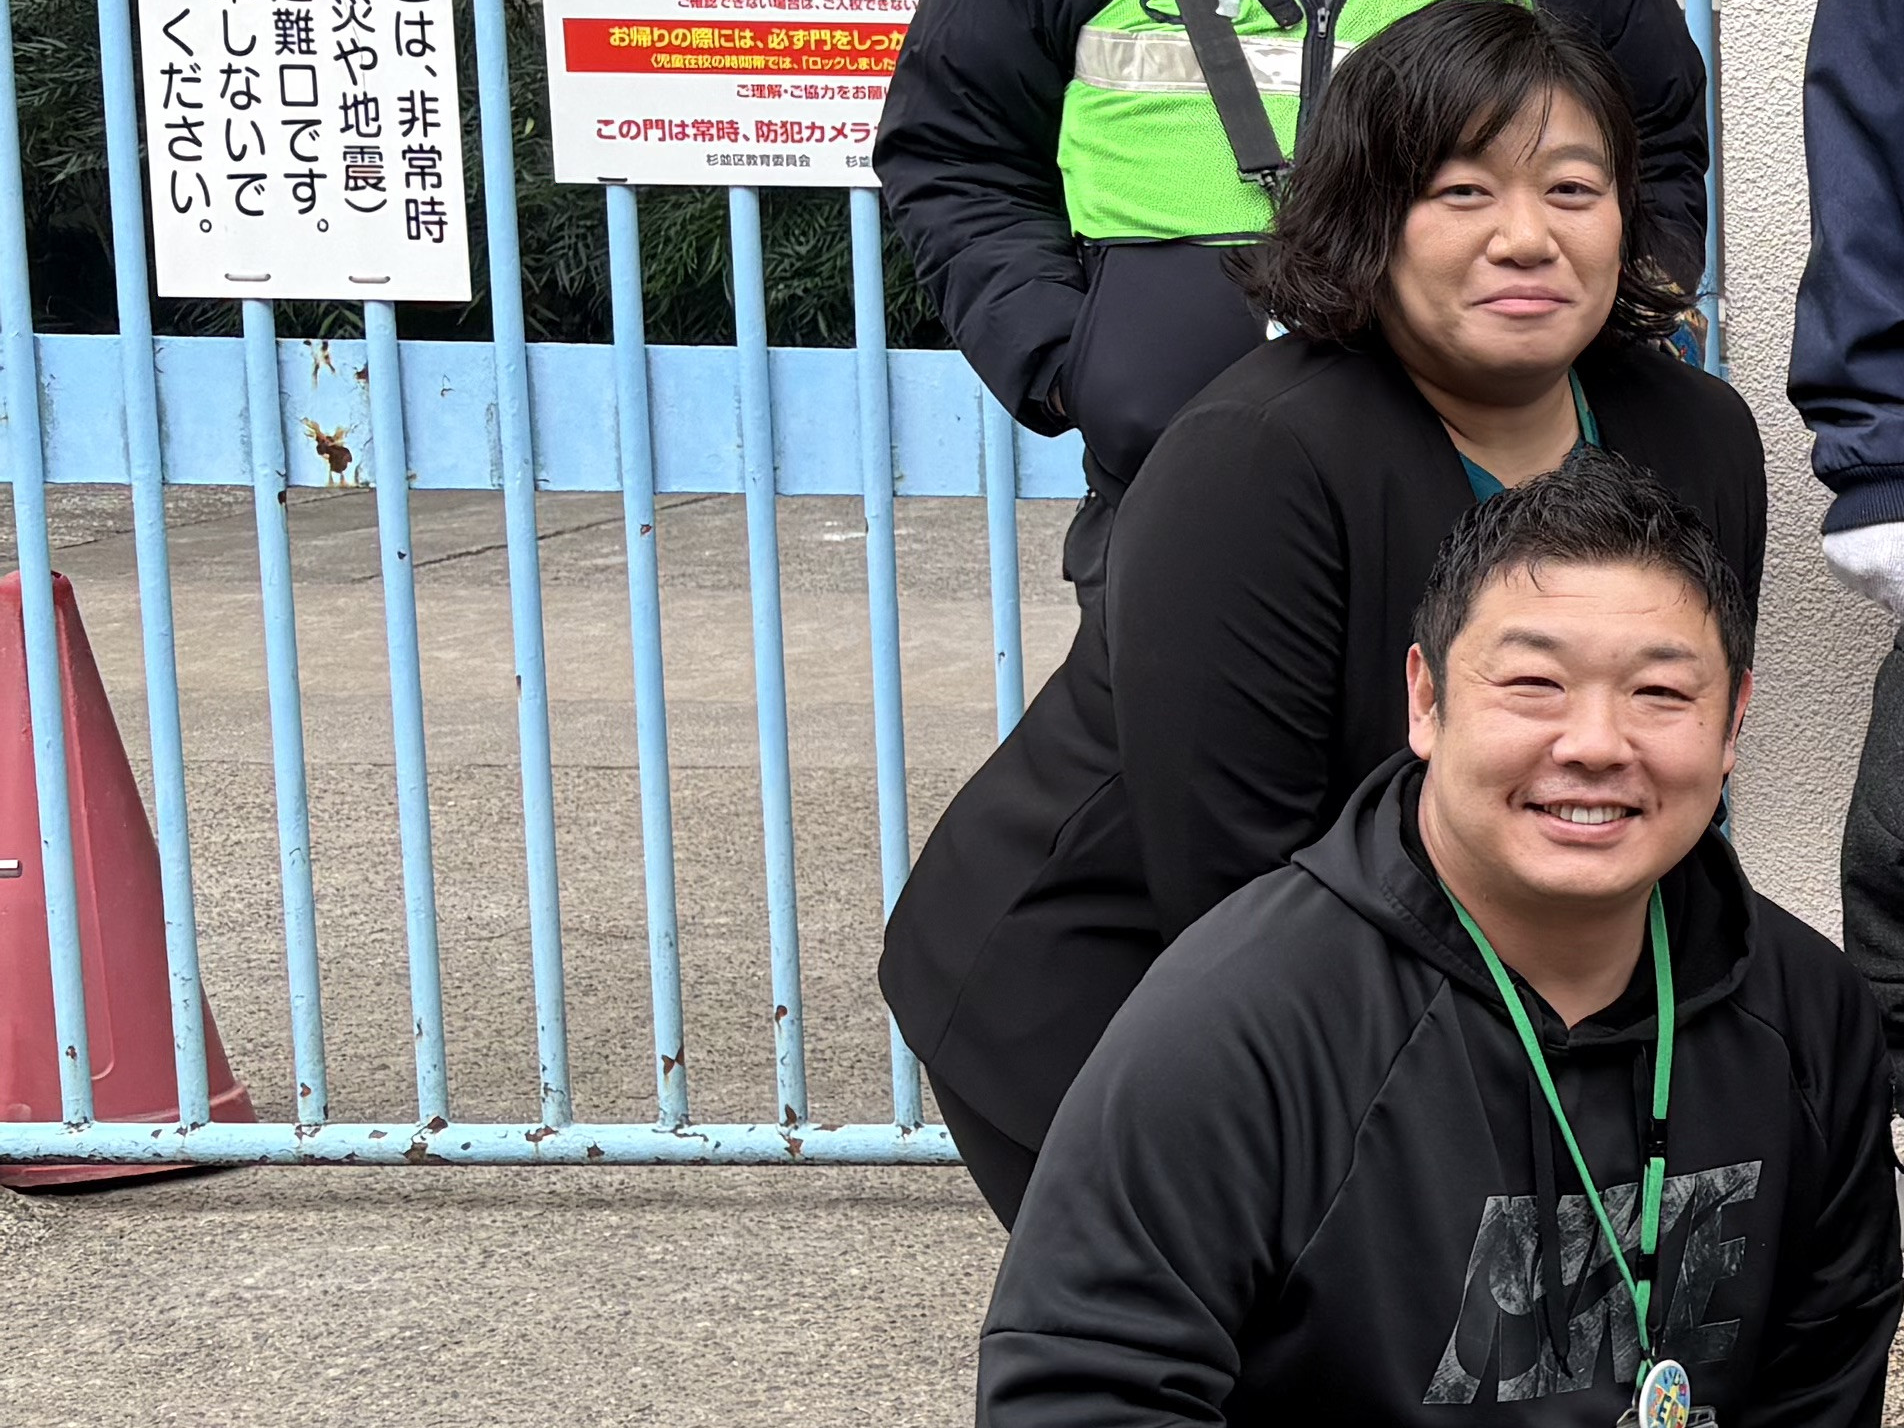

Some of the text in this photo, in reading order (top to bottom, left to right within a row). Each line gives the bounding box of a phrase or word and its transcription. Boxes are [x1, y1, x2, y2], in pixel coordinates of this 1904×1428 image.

[160, 8, 213, 234] ください。
[596, 118, 878, 143] この門は常時、防犯カメラ
